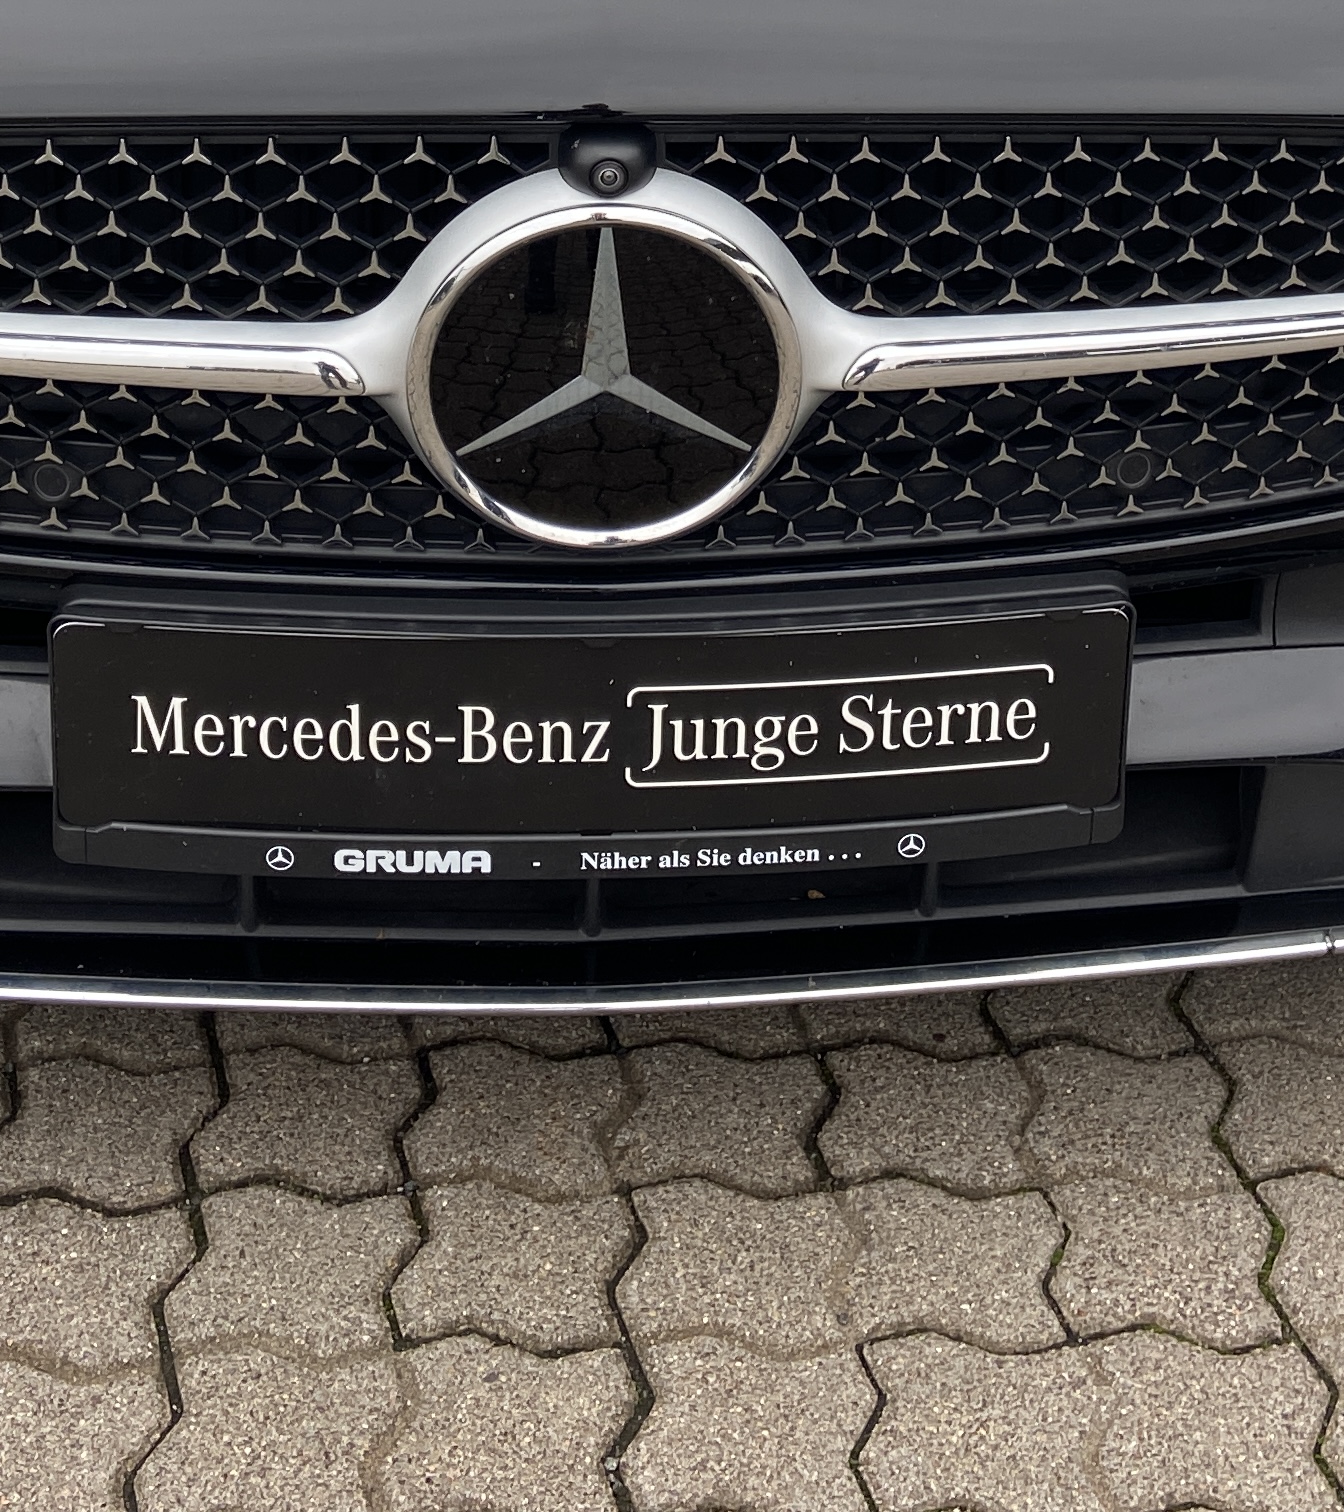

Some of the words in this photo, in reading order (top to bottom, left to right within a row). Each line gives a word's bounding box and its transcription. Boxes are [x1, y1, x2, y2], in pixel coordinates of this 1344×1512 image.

[130, 694, 612, 764] Mercedes-Benz
[641, 702, 819, 772] Junge
[839, 693, 1038, 756] Sterne
[333, 848, 493, 876] GRUMA
[579, 851, 653, 871] Näher
[658, 850, 691, 869] als
[696, 847, 732, 868] Sie
[737, 845, 821, 866] denken
